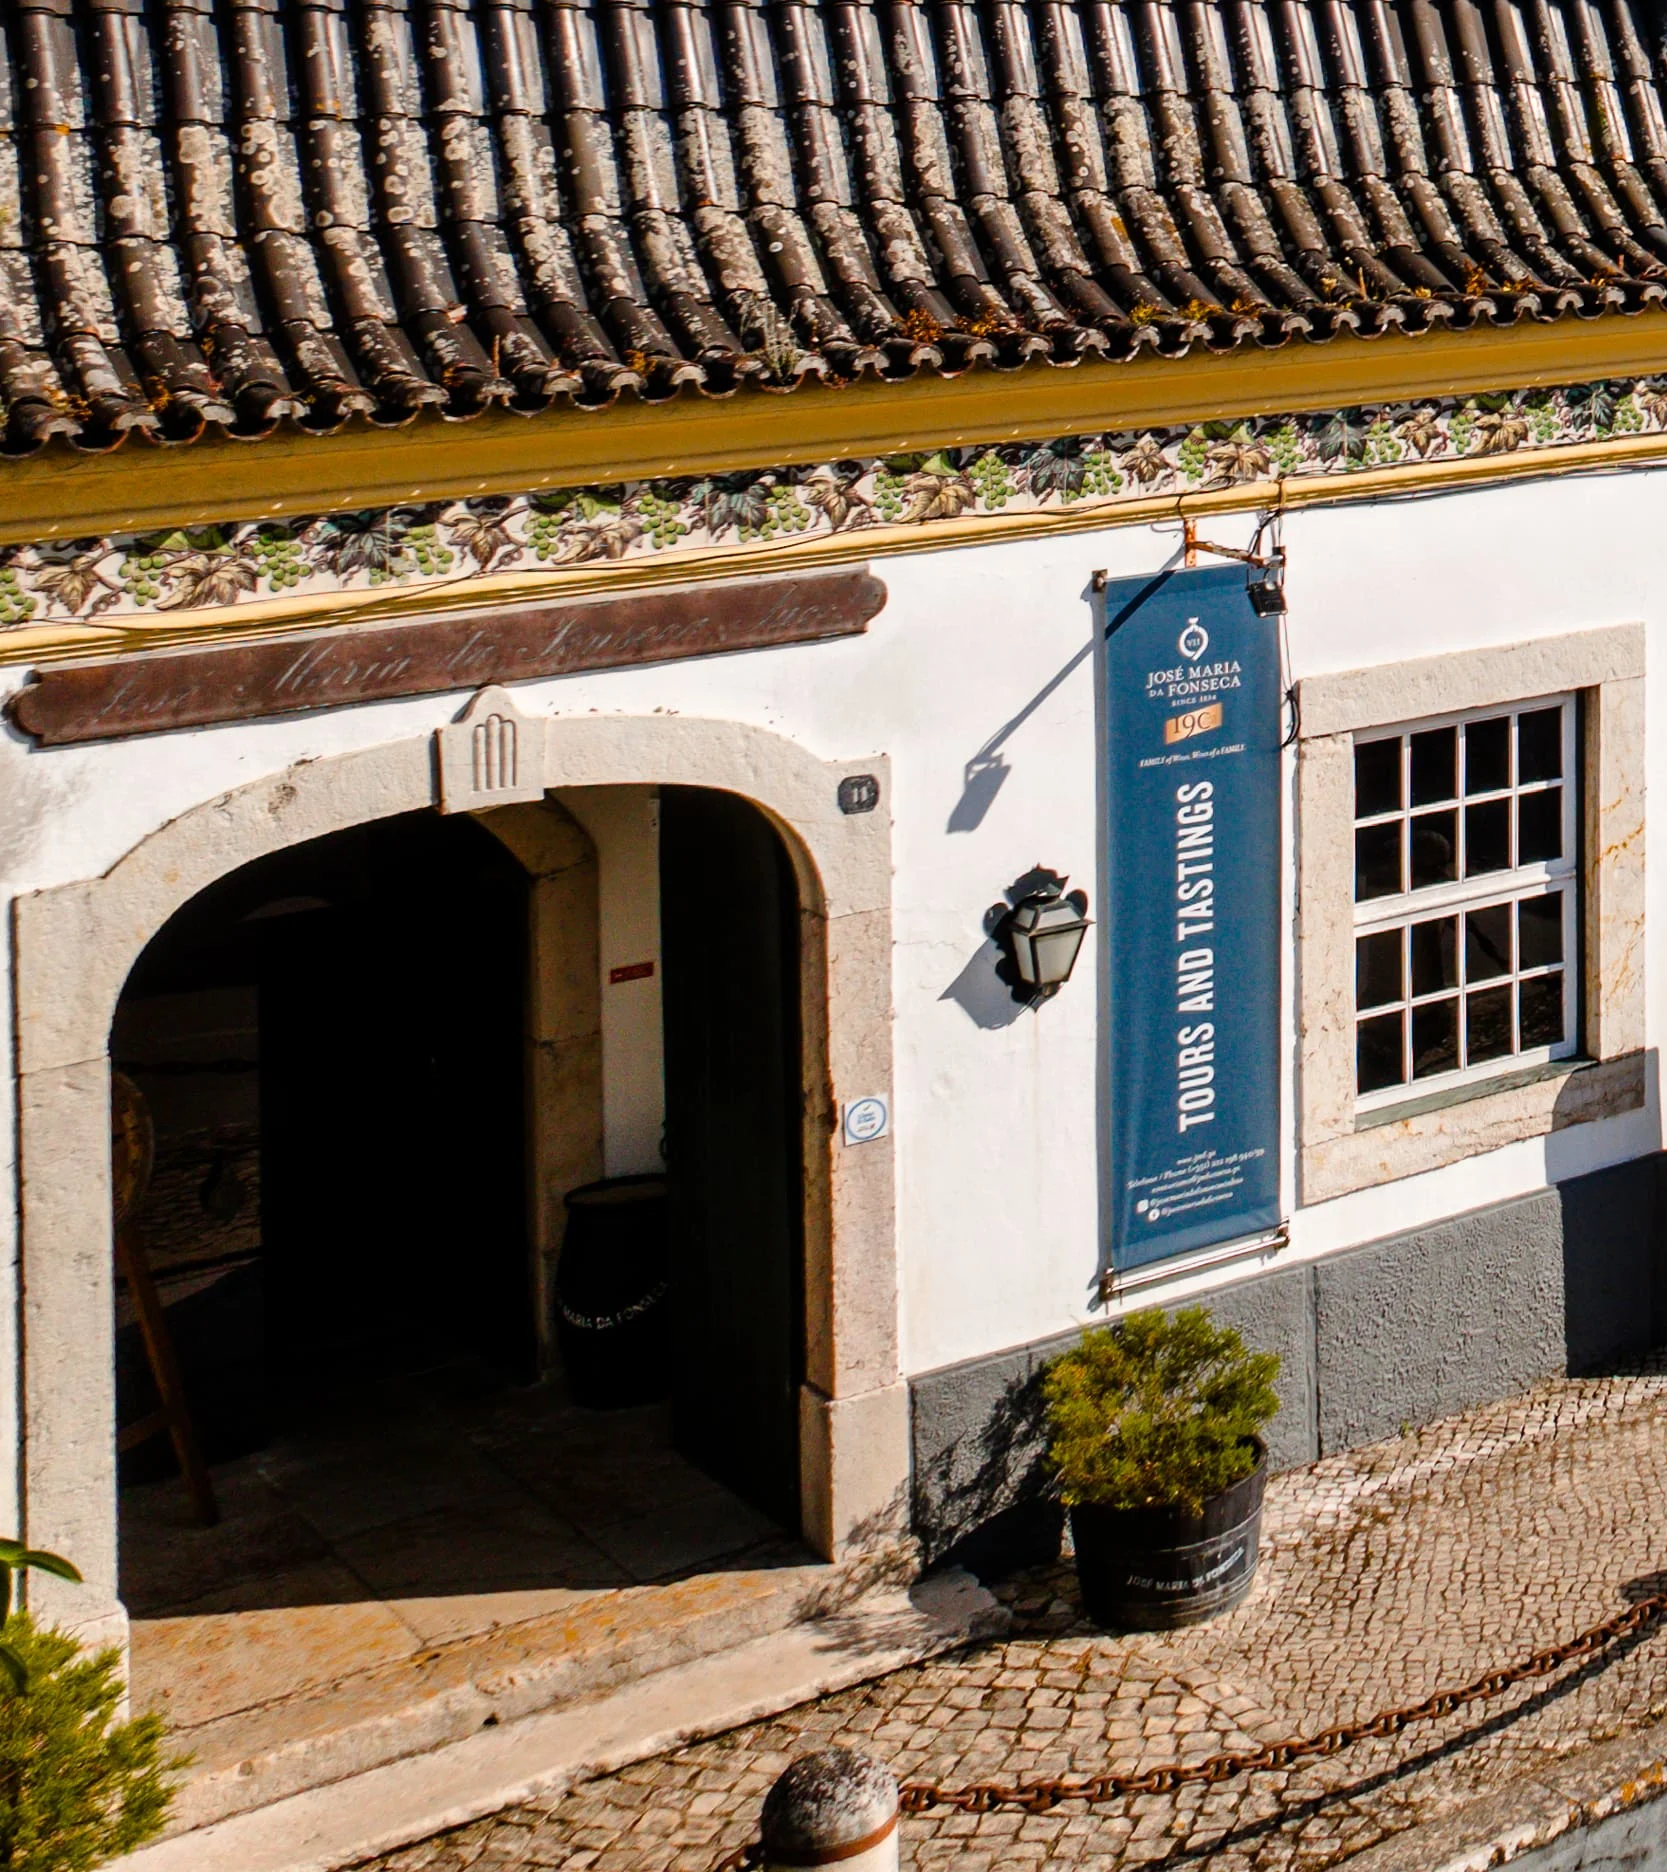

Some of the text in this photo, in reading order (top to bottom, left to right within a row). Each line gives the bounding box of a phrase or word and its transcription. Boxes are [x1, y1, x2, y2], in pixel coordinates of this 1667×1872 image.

[1146, 660, 1242, 689] JOSÉ MARIA
[1149, 675, 1242, 698] DA FONSECA
[1171, 696, 1197, 707] SINCE
[1176, 780, 1214, 942] TASTINGS
[1178, 947, 1214, 1012] AND
[1178, 1021, 1216, 1134] TOURS
